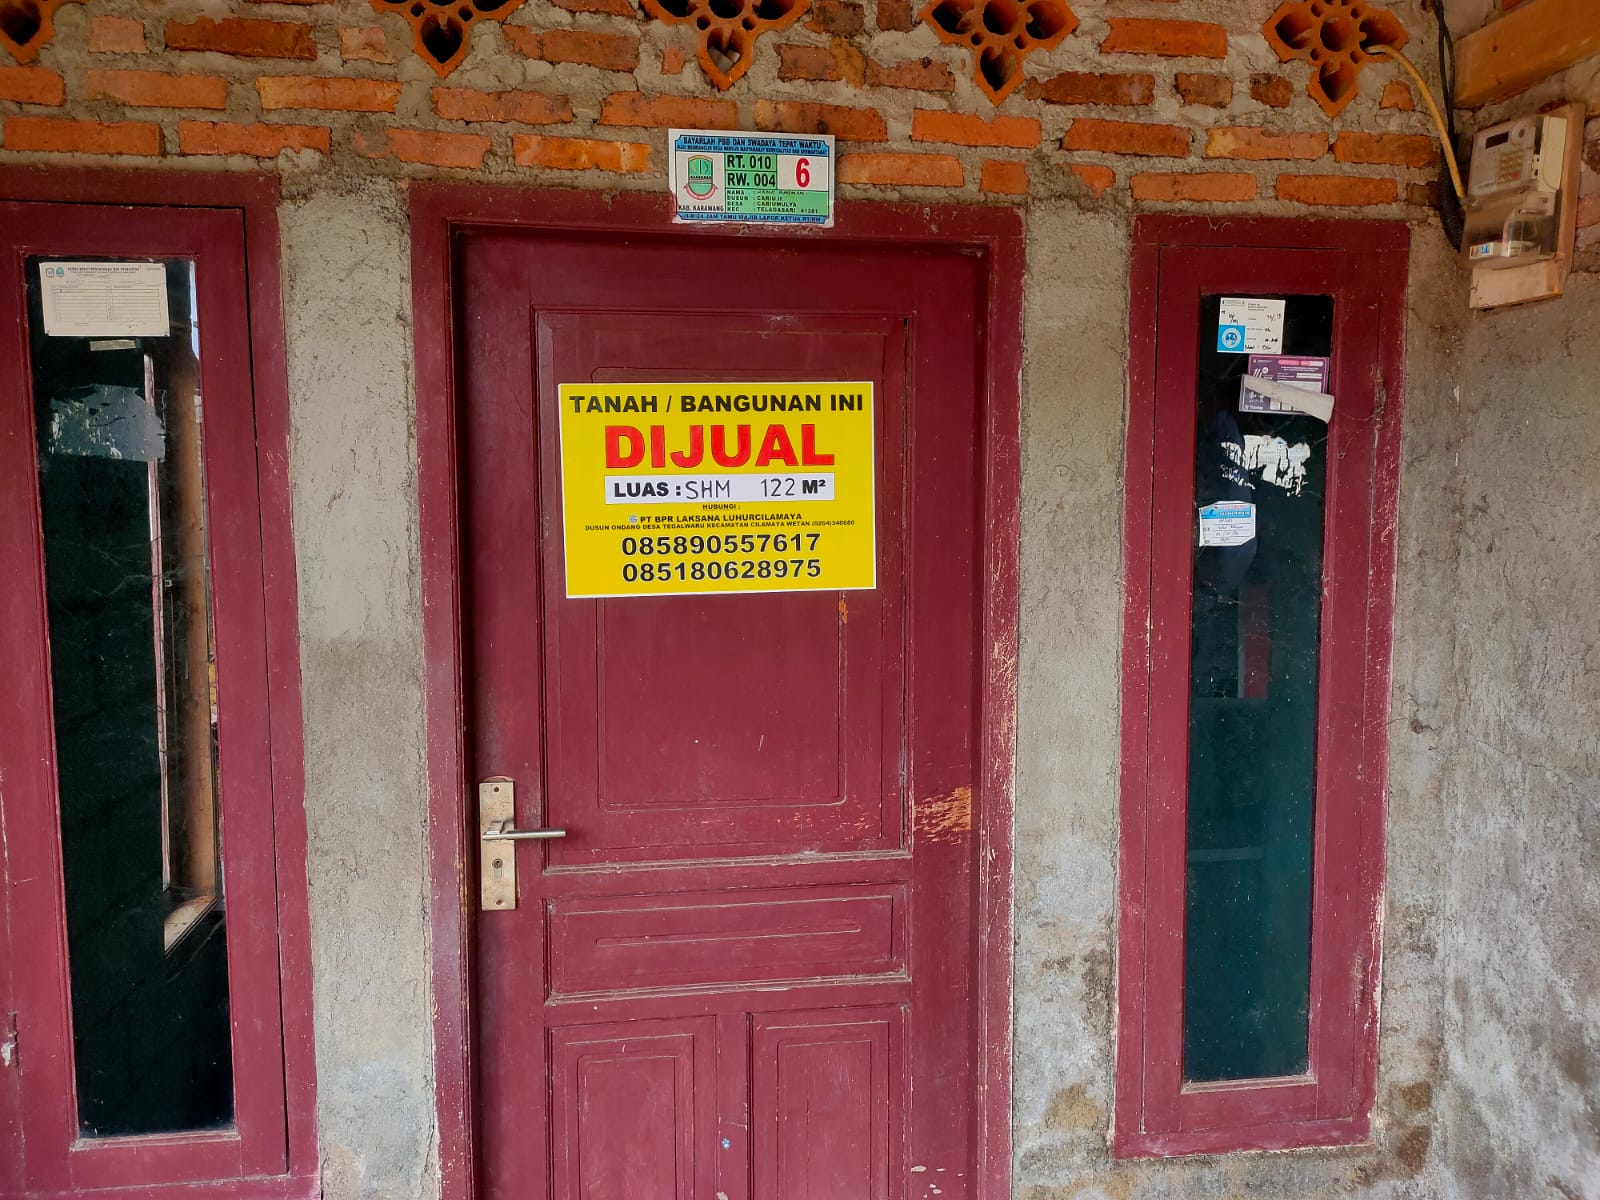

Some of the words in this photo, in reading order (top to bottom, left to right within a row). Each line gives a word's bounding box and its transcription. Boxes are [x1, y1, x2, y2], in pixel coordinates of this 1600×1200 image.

[684, 136, 716, 144] BAYARLAH
[732, 138, 746, 146] DAN
[748, 138, 776, 147] SWADAYA
[727, 155, 746, 168] RT.
[749, 156, 771, 169] 010
[796, 157, 810, 188] 6
[727, 172, 750, 187] RW.
[754, 173, 776, 187] 004
[570, 395, 658, 413] TANAH
[666, 395, 672, 412] /
[680, 394, 821, 412] BANGUNAN
[830, 394, 863, 411] INI
[605, 424, 835, 468] DIJUAL
[614, 482, 669, 498] LUAS
[685, 480, 731, 500] SHM
[760, 478, 796, 498] 122
[621, 533, 821, 556] 085890557617
[622, 559, 821, 582] 085180628975
